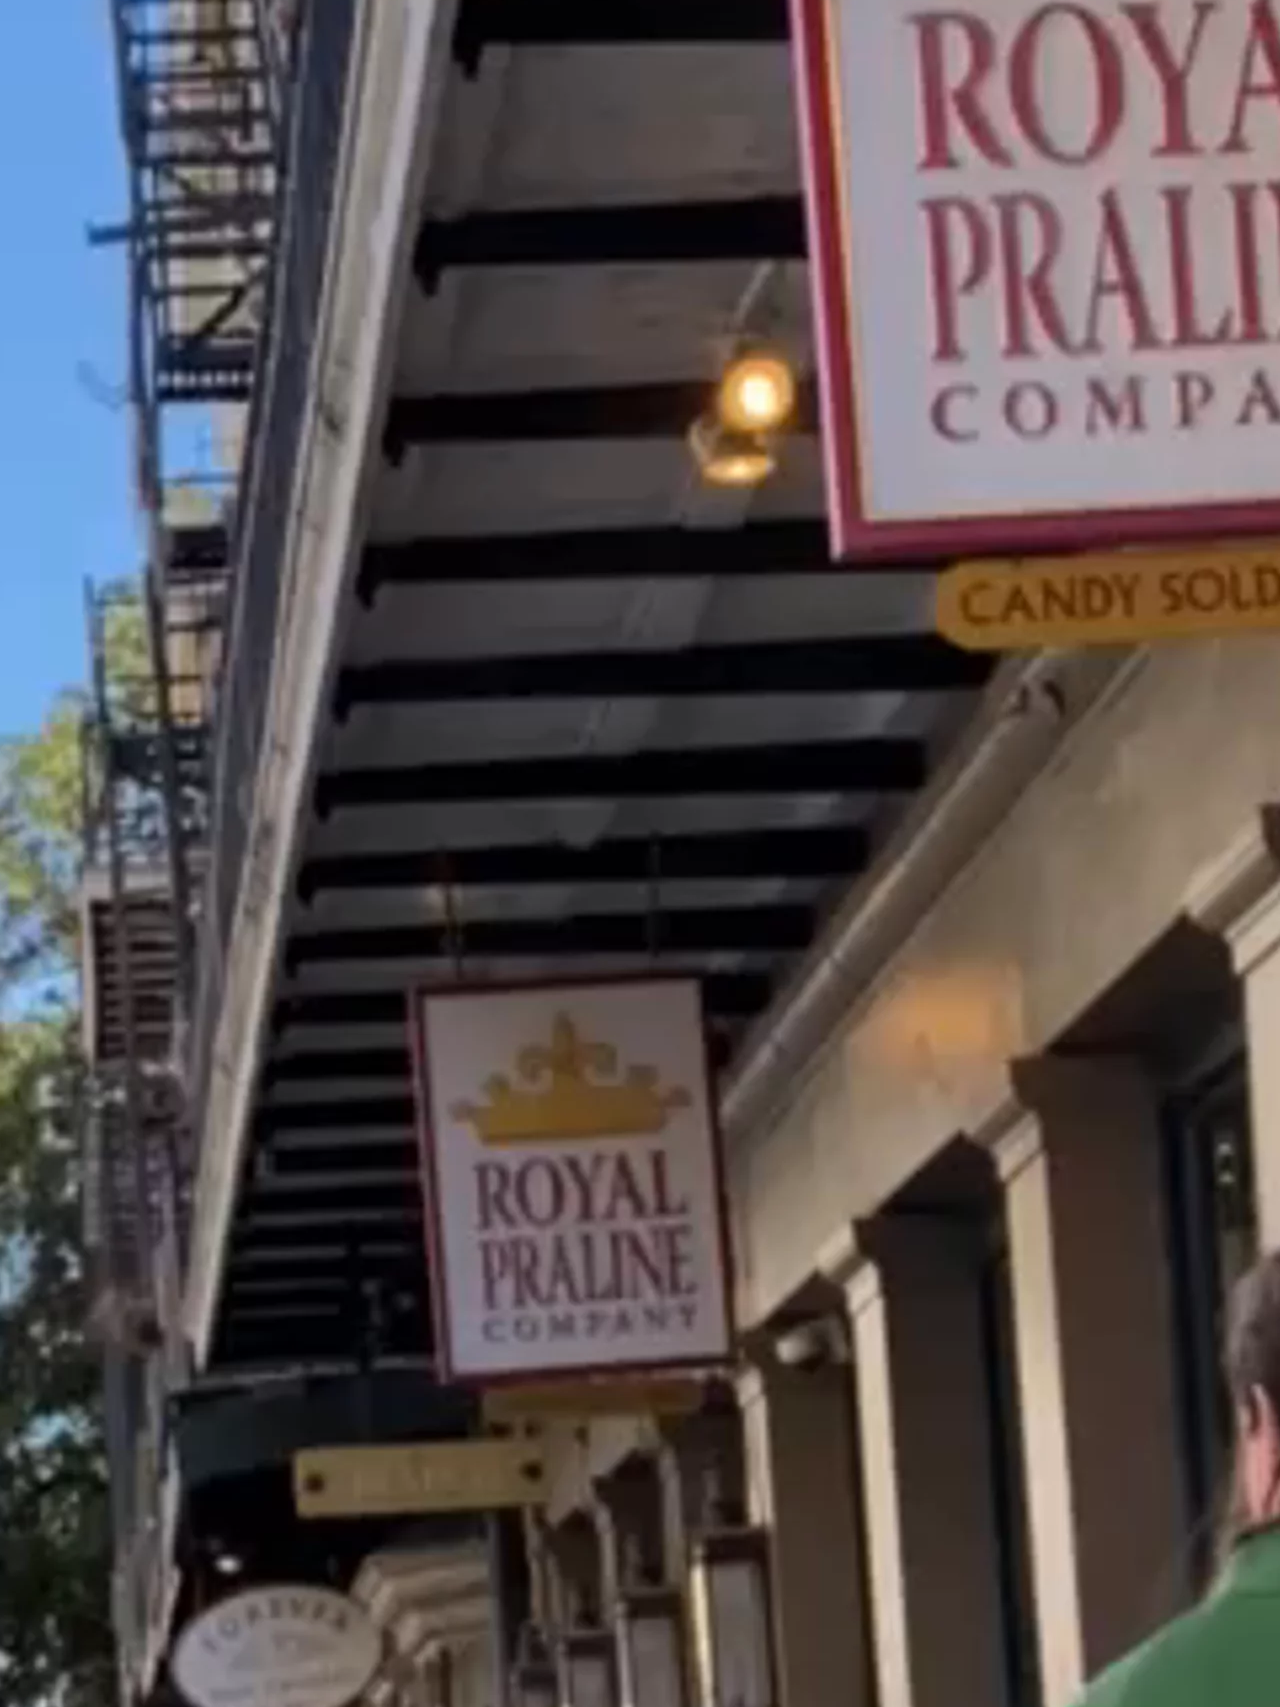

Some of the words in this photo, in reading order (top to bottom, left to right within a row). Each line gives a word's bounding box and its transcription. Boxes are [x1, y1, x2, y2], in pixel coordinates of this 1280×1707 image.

[959, 572, 1140, 626] CANDY
[473, 1149, 691, 1230] ROYAL
[478, 1223, 698, 1310] PRALINE
[481, 1303, 698, 1343] COMPANY
